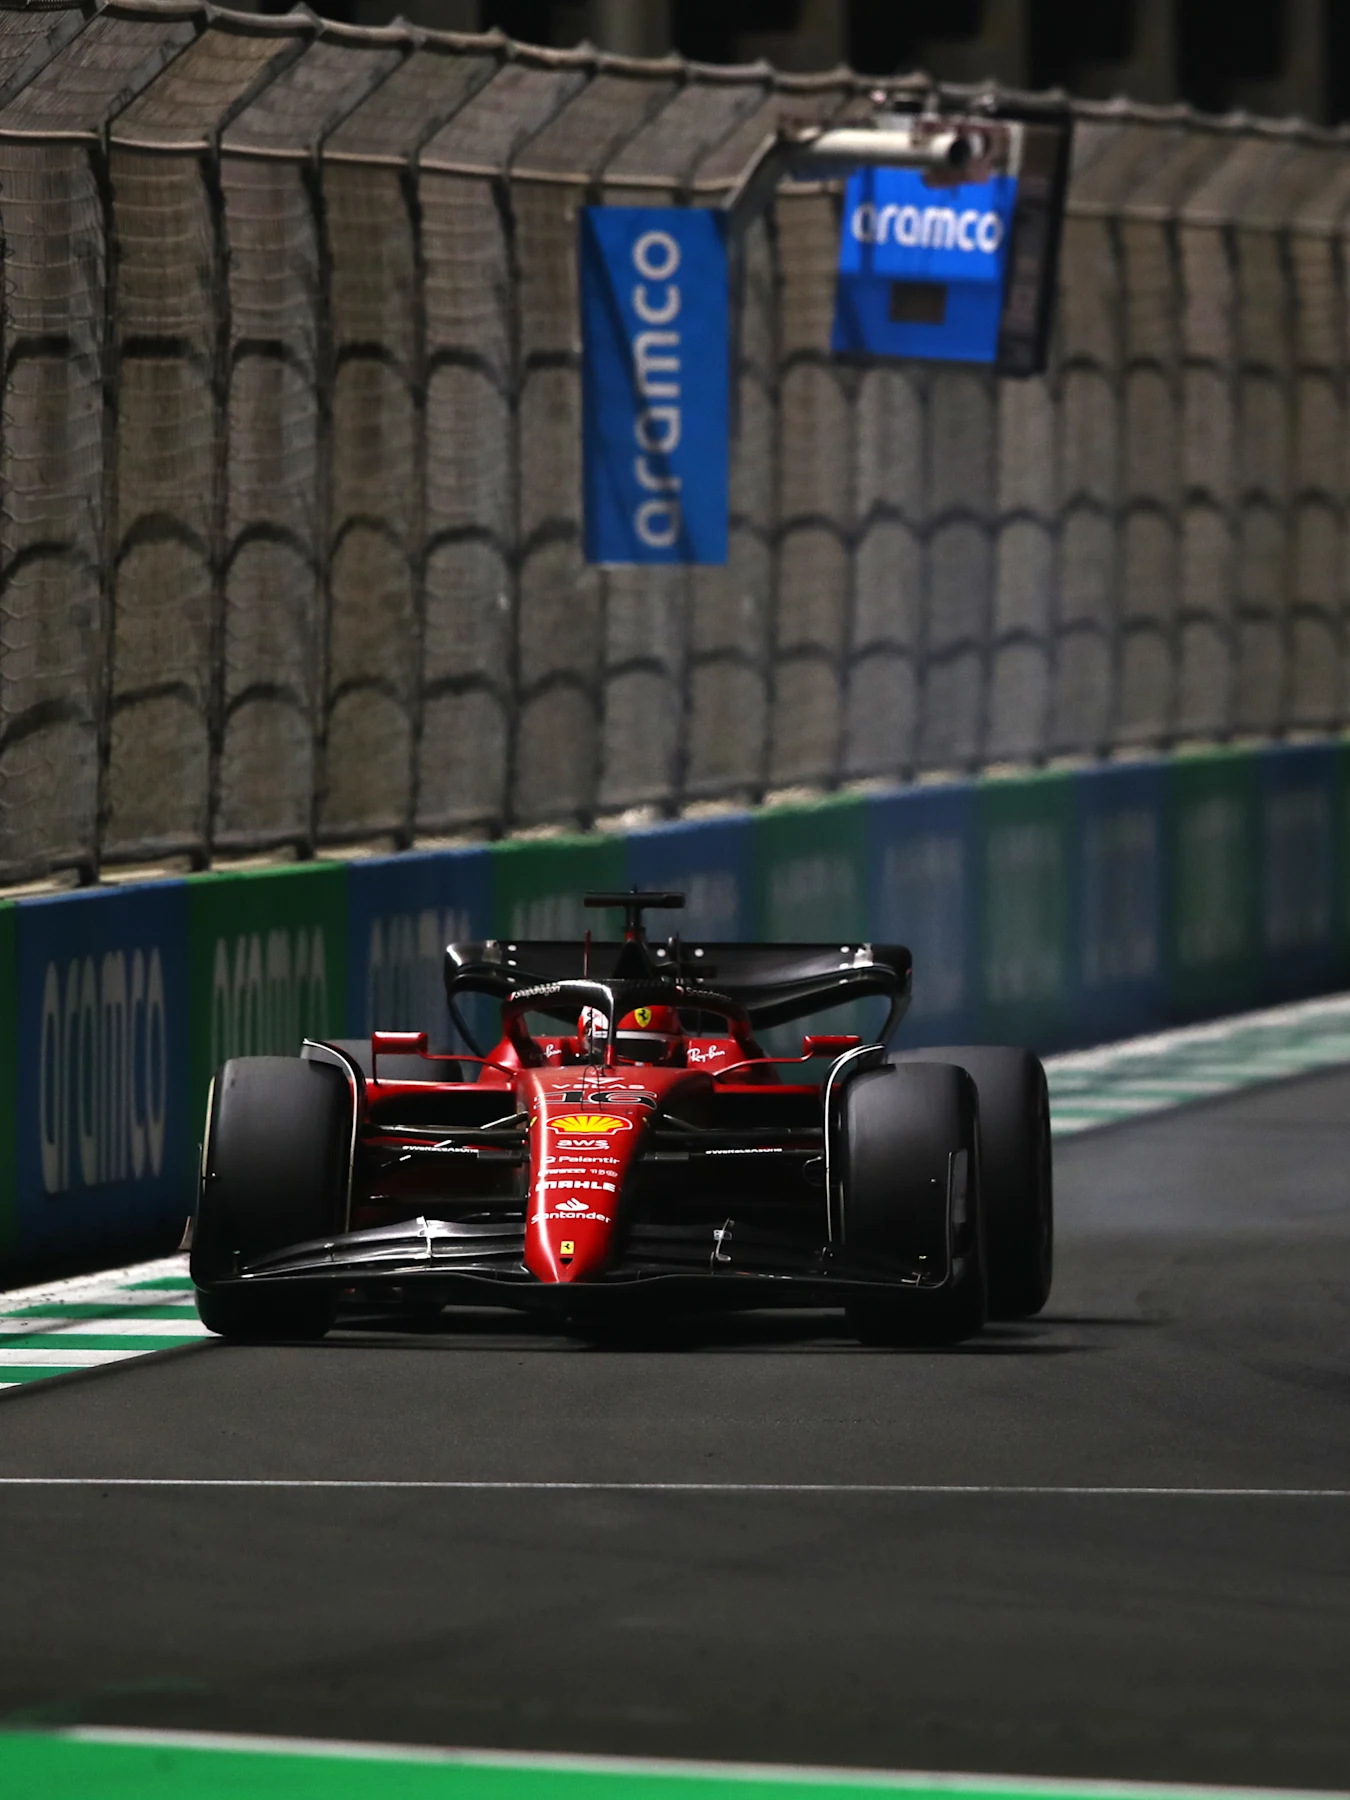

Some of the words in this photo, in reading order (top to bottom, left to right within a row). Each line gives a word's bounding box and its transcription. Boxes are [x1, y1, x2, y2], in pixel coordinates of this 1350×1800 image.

[849, 202, 1002, 254] aramco
[632, 230, 682, 548] aramco
[40, 944, 167, 1194] aramco
[556, 1139, 609, 1149] aws
[558, 1155, 621, 1165] Palantir
[535, 1179, 617, 1193] MAHLE
[531, 1210, 612, 1225] Santander
